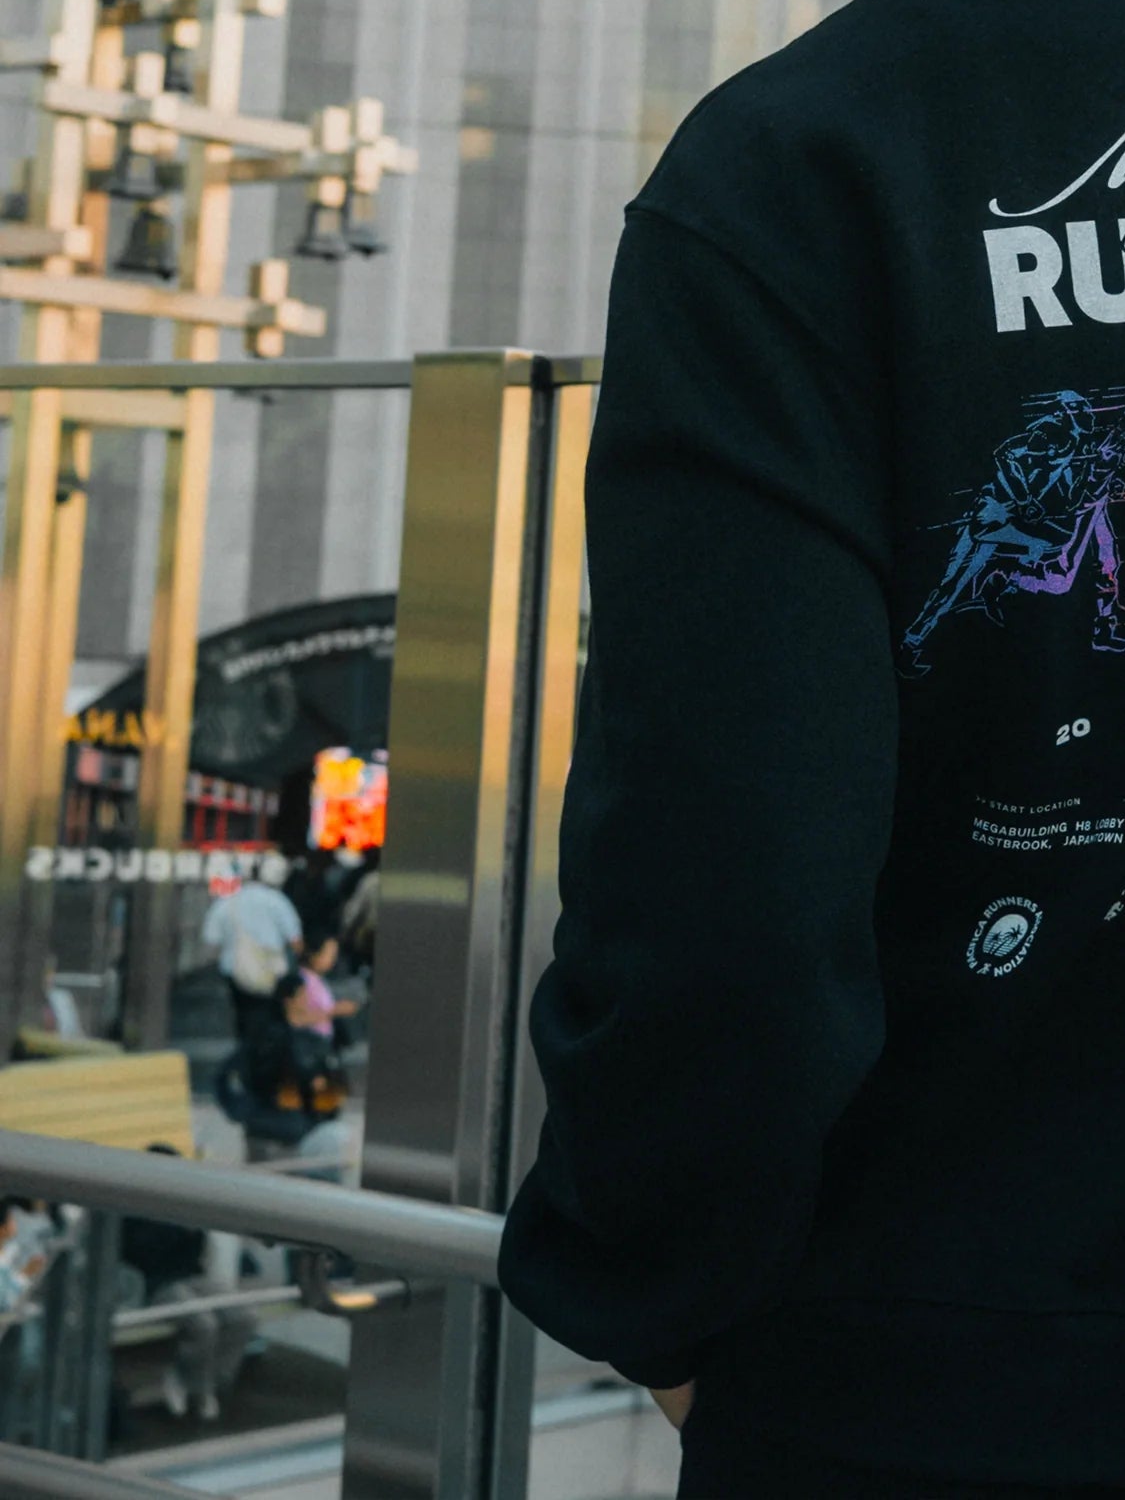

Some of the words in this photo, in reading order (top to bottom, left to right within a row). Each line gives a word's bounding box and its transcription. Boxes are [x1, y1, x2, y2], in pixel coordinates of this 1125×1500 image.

[1056, 718, 1091, 746] 20
[989, 800, 1025, 814] START
[1030, 797, 1081, 814] LOCATION
[973, 817, 1068, 838] MEGABUILDING
[1063, 832, 1124, 846] JAPANTOWN
[983, 896, 1038, 919] RUNNERS
